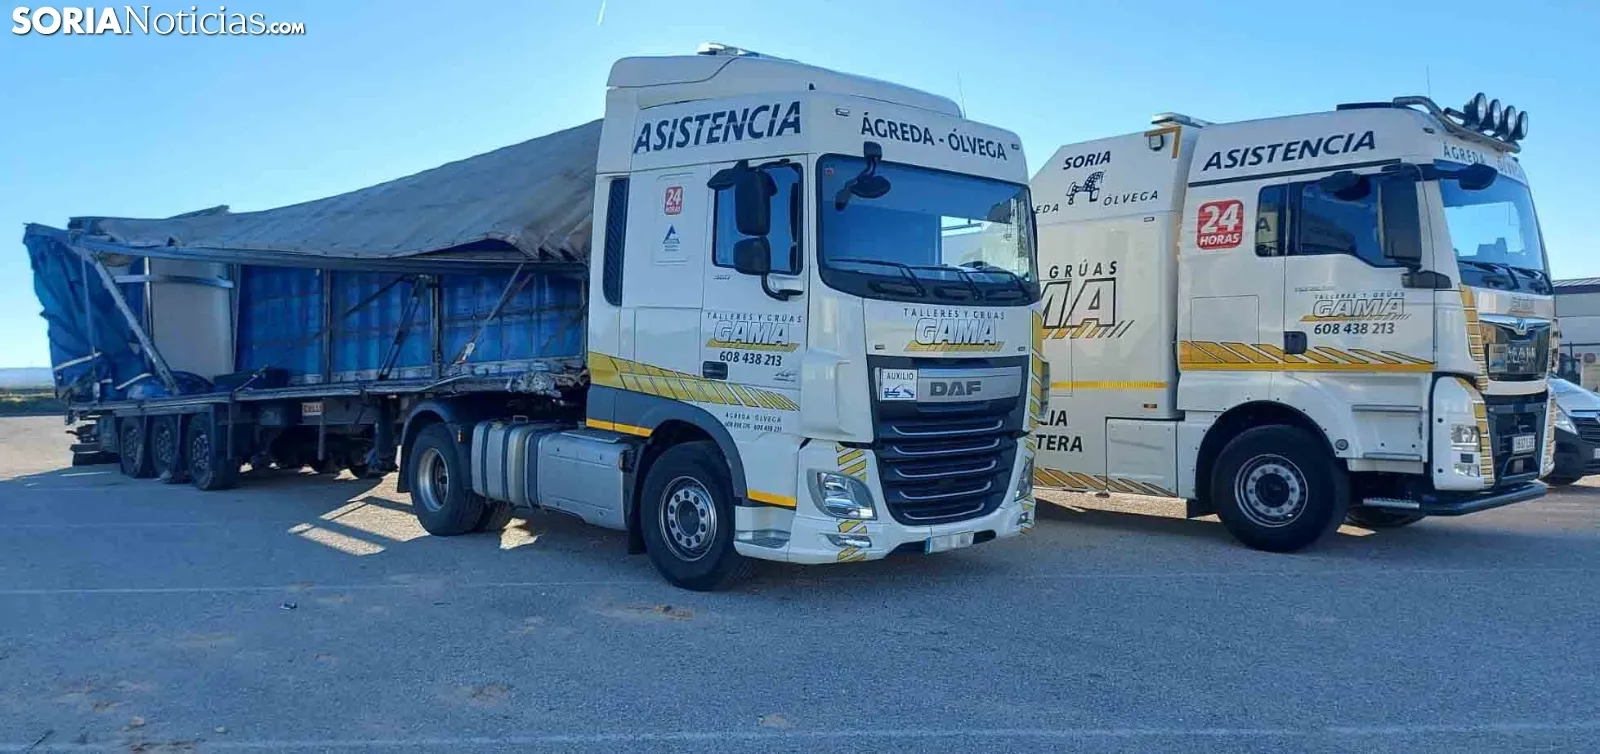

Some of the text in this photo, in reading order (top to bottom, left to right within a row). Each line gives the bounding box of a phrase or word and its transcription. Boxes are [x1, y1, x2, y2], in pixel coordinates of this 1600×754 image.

[633, 100, 801, 154] ASISTENCIA
[861, 111, 936, 146] ÁGREDA
[947, 127, 1008, 161] ÓLVEGA
[1063, 150, 1111, 170] SORIA
[1202, 130, 1376, 171] ASISTENCIA
[666, 188, 682, 206] 24
[1103, 190, 1159, 206] ÓLVEGA
[1200, 203, 1240, 234] 24
[1199, 233, 1241, 246] HORAS
[1049, 259, 1118, 279] GRÚAS
[706, 312, 753, 320] TALLERES
[903, 308, 960, 318] TALLERES
[1312, 298, 1405, 318] GAMA
[713, 319, 790, 347] GAMA
[914, 317, 997, 346] GAMA
[1313, 322, 1396, 335] 608 438 213
[719, 351, 783, 367] 608 438 213
[886, 372, 915, 381] AUXILIO
[929, 380, 982, 397] DAF
[1035, 434, 1083, 453] TERA
